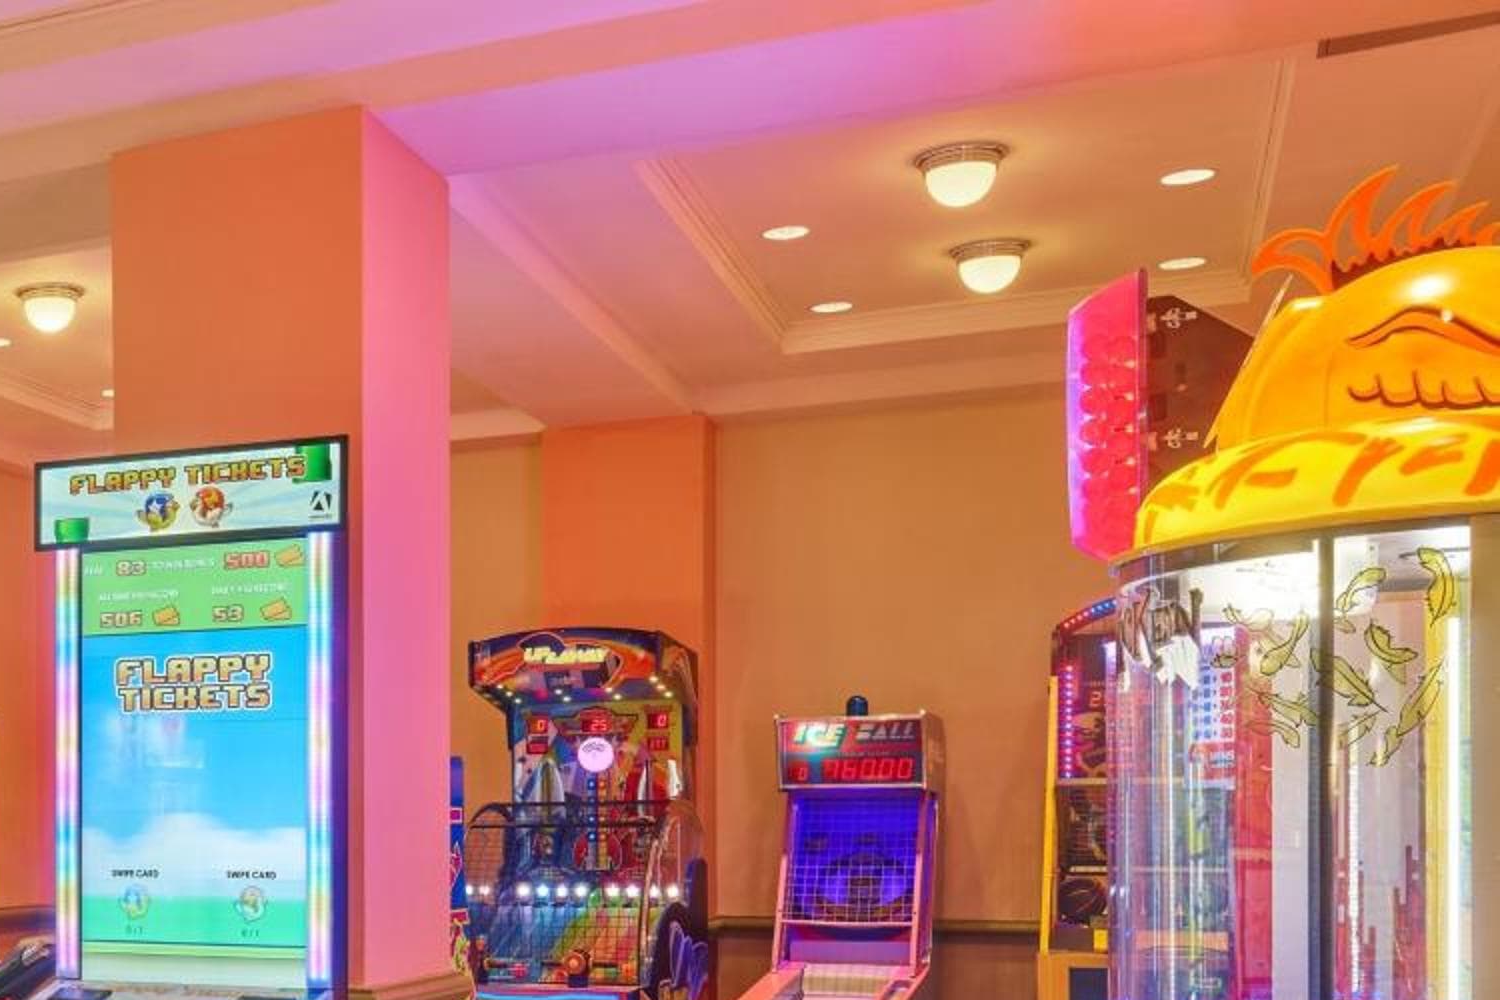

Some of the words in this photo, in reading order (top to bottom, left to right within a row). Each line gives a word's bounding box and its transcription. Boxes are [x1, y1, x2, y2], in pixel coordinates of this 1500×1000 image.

[69, 466, 176, 495] FLAPPY
[184, 456, 306, 486] TICKETS
[116, 561, 147, 576] 83
[224, 551, 270, 570] 500
[100, 612, 143, 629] 506
[116, 655, 271, 689] FLAPPY
[117, 685, 271, 714] TICKETS
[793, 722, 847, 748] ICE
[111, 869, 135, 878] SWIPE
[135, 869, 159, 879] CARD
[226, 870, 250, 879] SWIPE
[252, 871, 277, 880] CARD
